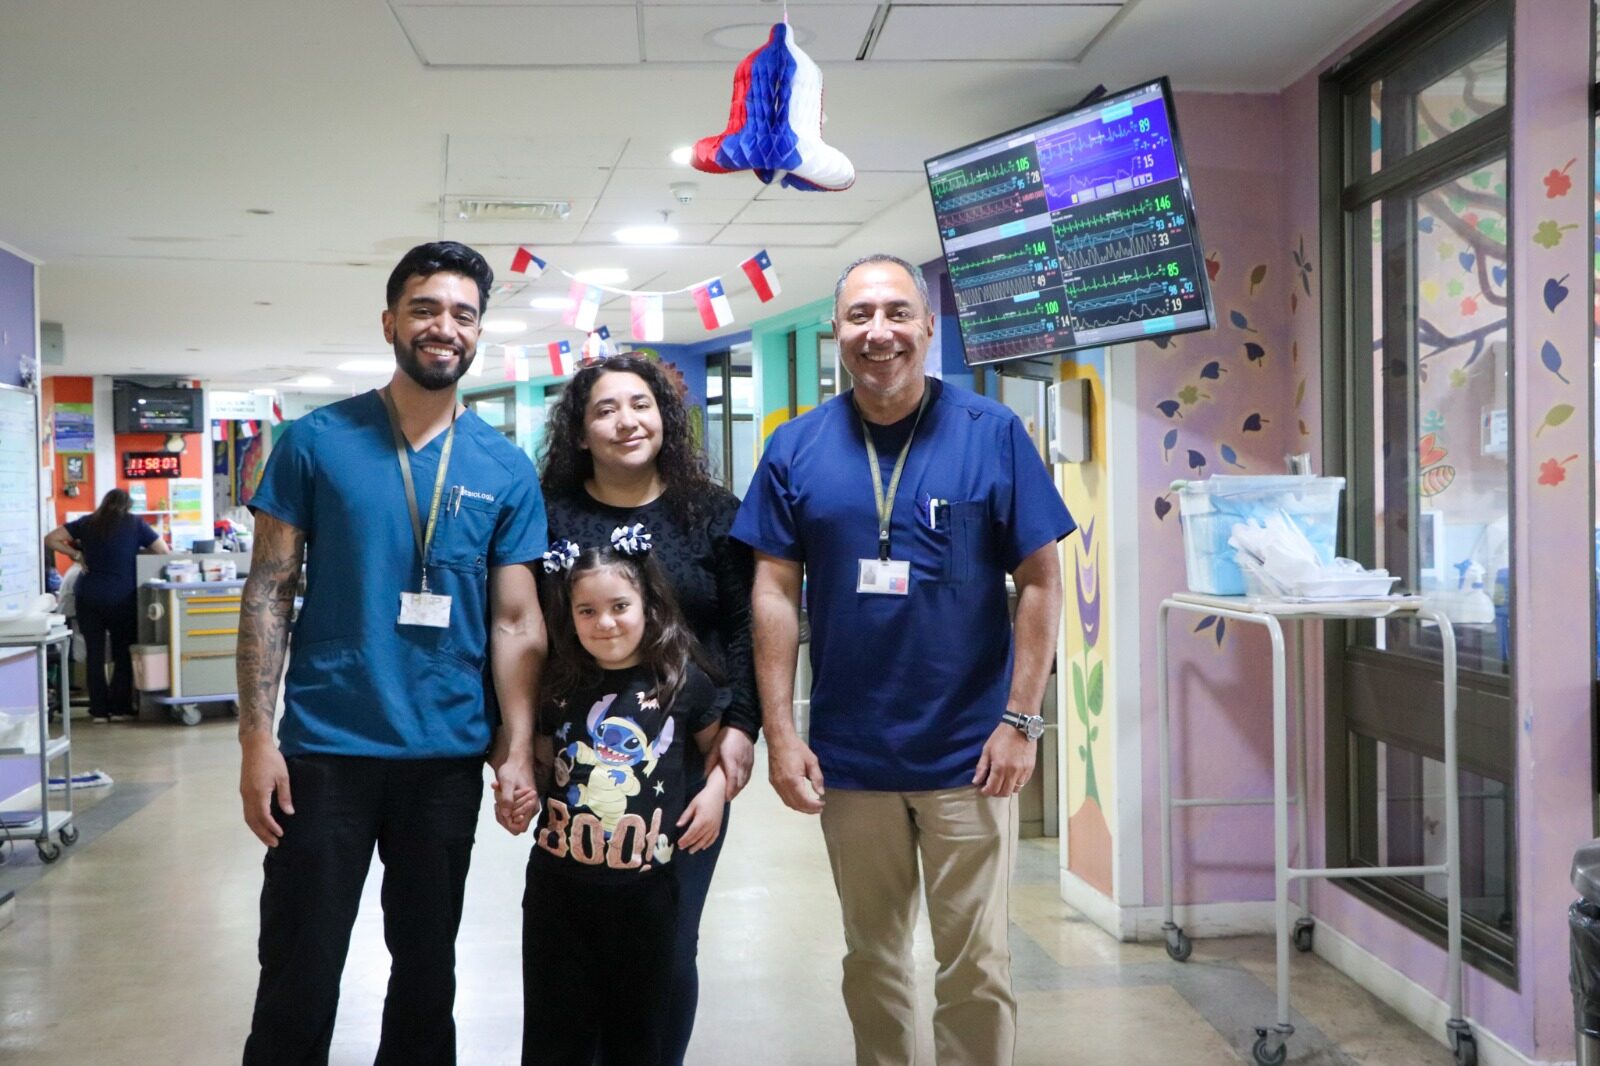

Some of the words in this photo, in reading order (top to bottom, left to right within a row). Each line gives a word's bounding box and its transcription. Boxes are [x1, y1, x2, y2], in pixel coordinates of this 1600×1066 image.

[1138, 118, 1150, 133] 89
[1143, 154, 1154, 168] 15
[1154, 195, 1171, 211] 146
[1158, 233, 1170, 246] 33
[1033, 241, 1046, 255] 144
[1167, 262, 1179, 277] 85
[1045, 301, 1059, 315] 100
[1171, 298, 1182, 311] 19
[1061, 315, 1070, 328] 14
[538, 797, 663, 872] BOO!
